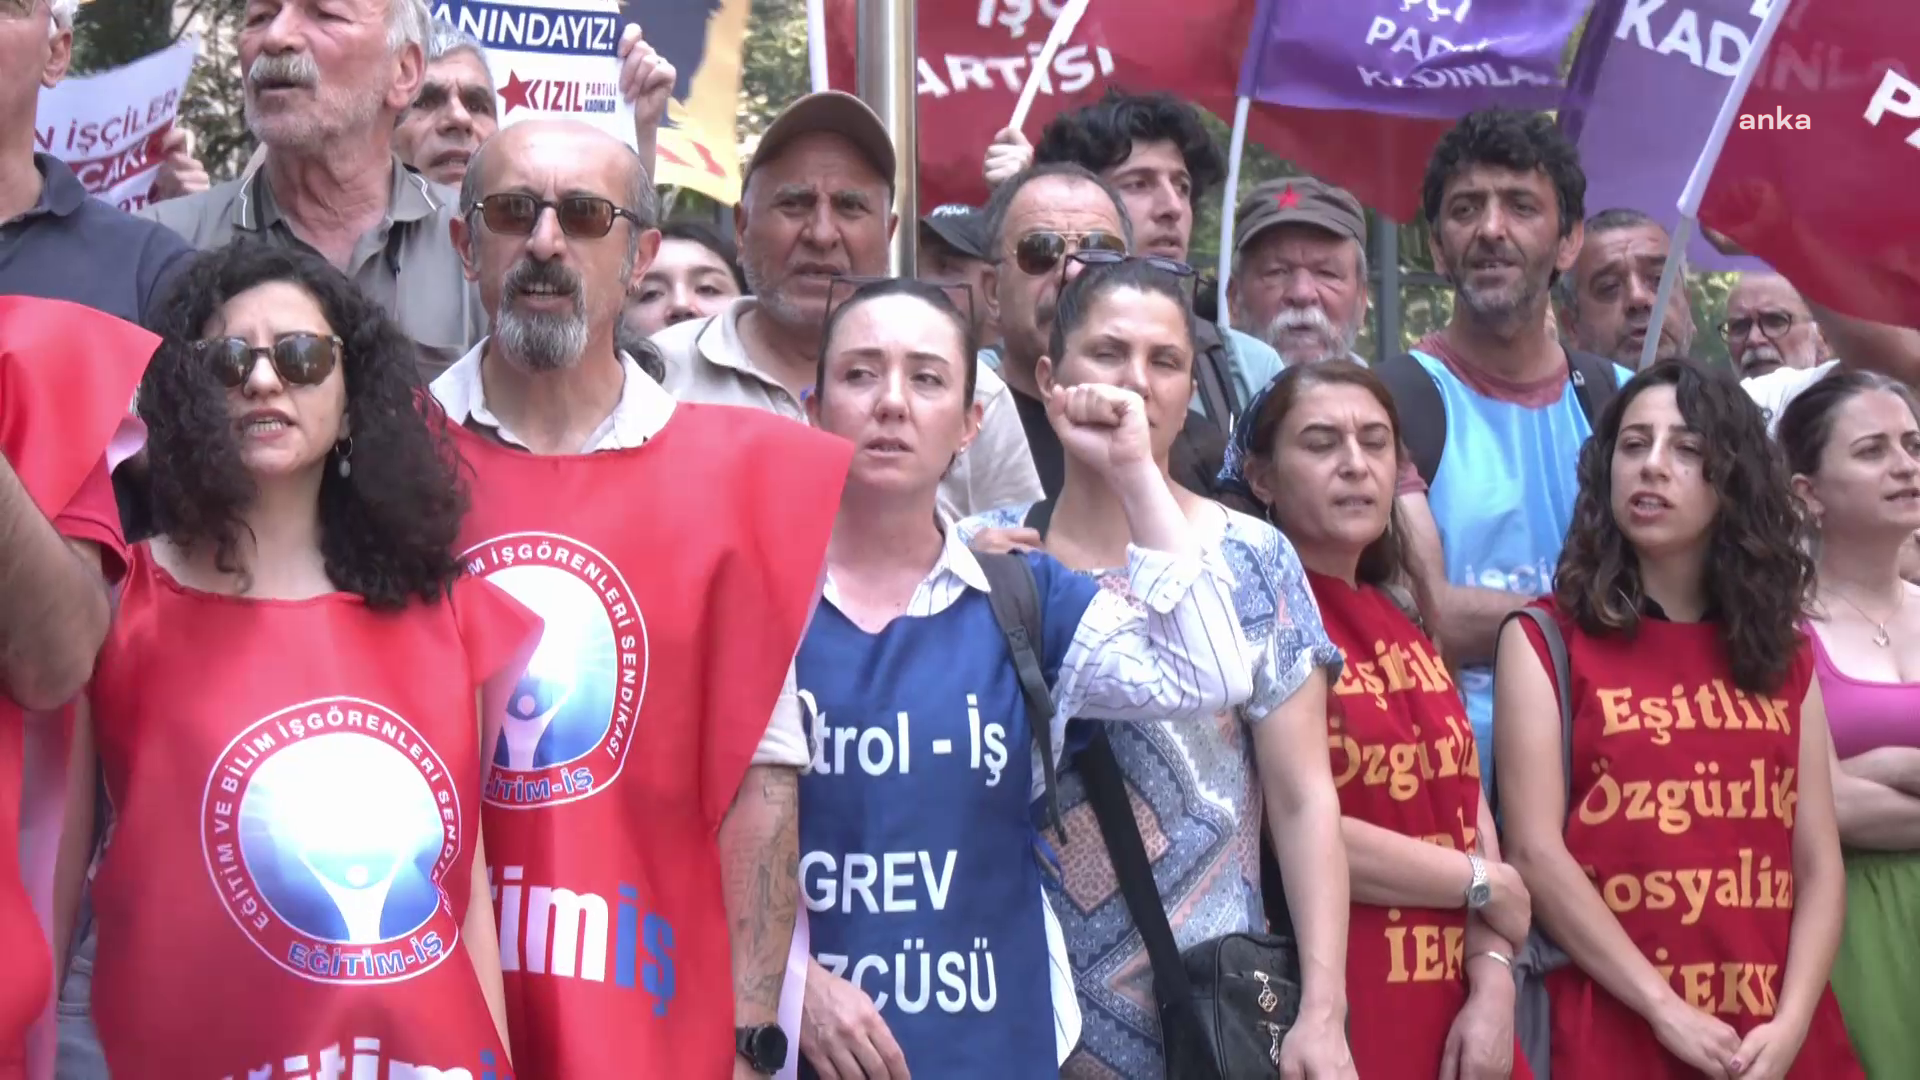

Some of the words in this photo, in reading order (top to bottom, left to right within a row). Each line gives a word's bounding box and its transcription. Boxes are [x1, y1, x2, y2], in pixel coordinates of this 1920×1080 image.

[66, 88, 177, 156] İŞÇİLER
[491, 541, 634, 628] İŞGÖRENLERİ
[606, 635, 637, 760] SENDİKASI
[276, 705, 442, 783] İŞGÖRENLERİ
[966, 694, 1008, 787] İş
[1596, 679, 1791, 746] Eşitlik
[220, 731, 276, 794] BİLİM
[214, 800, 233, 834] VE
[216, 842, 270, 932] EĞİTİM
[799, 850, 958, 914] GREV
[288, 932, 443, 977] EĞİTİM-İŞ
